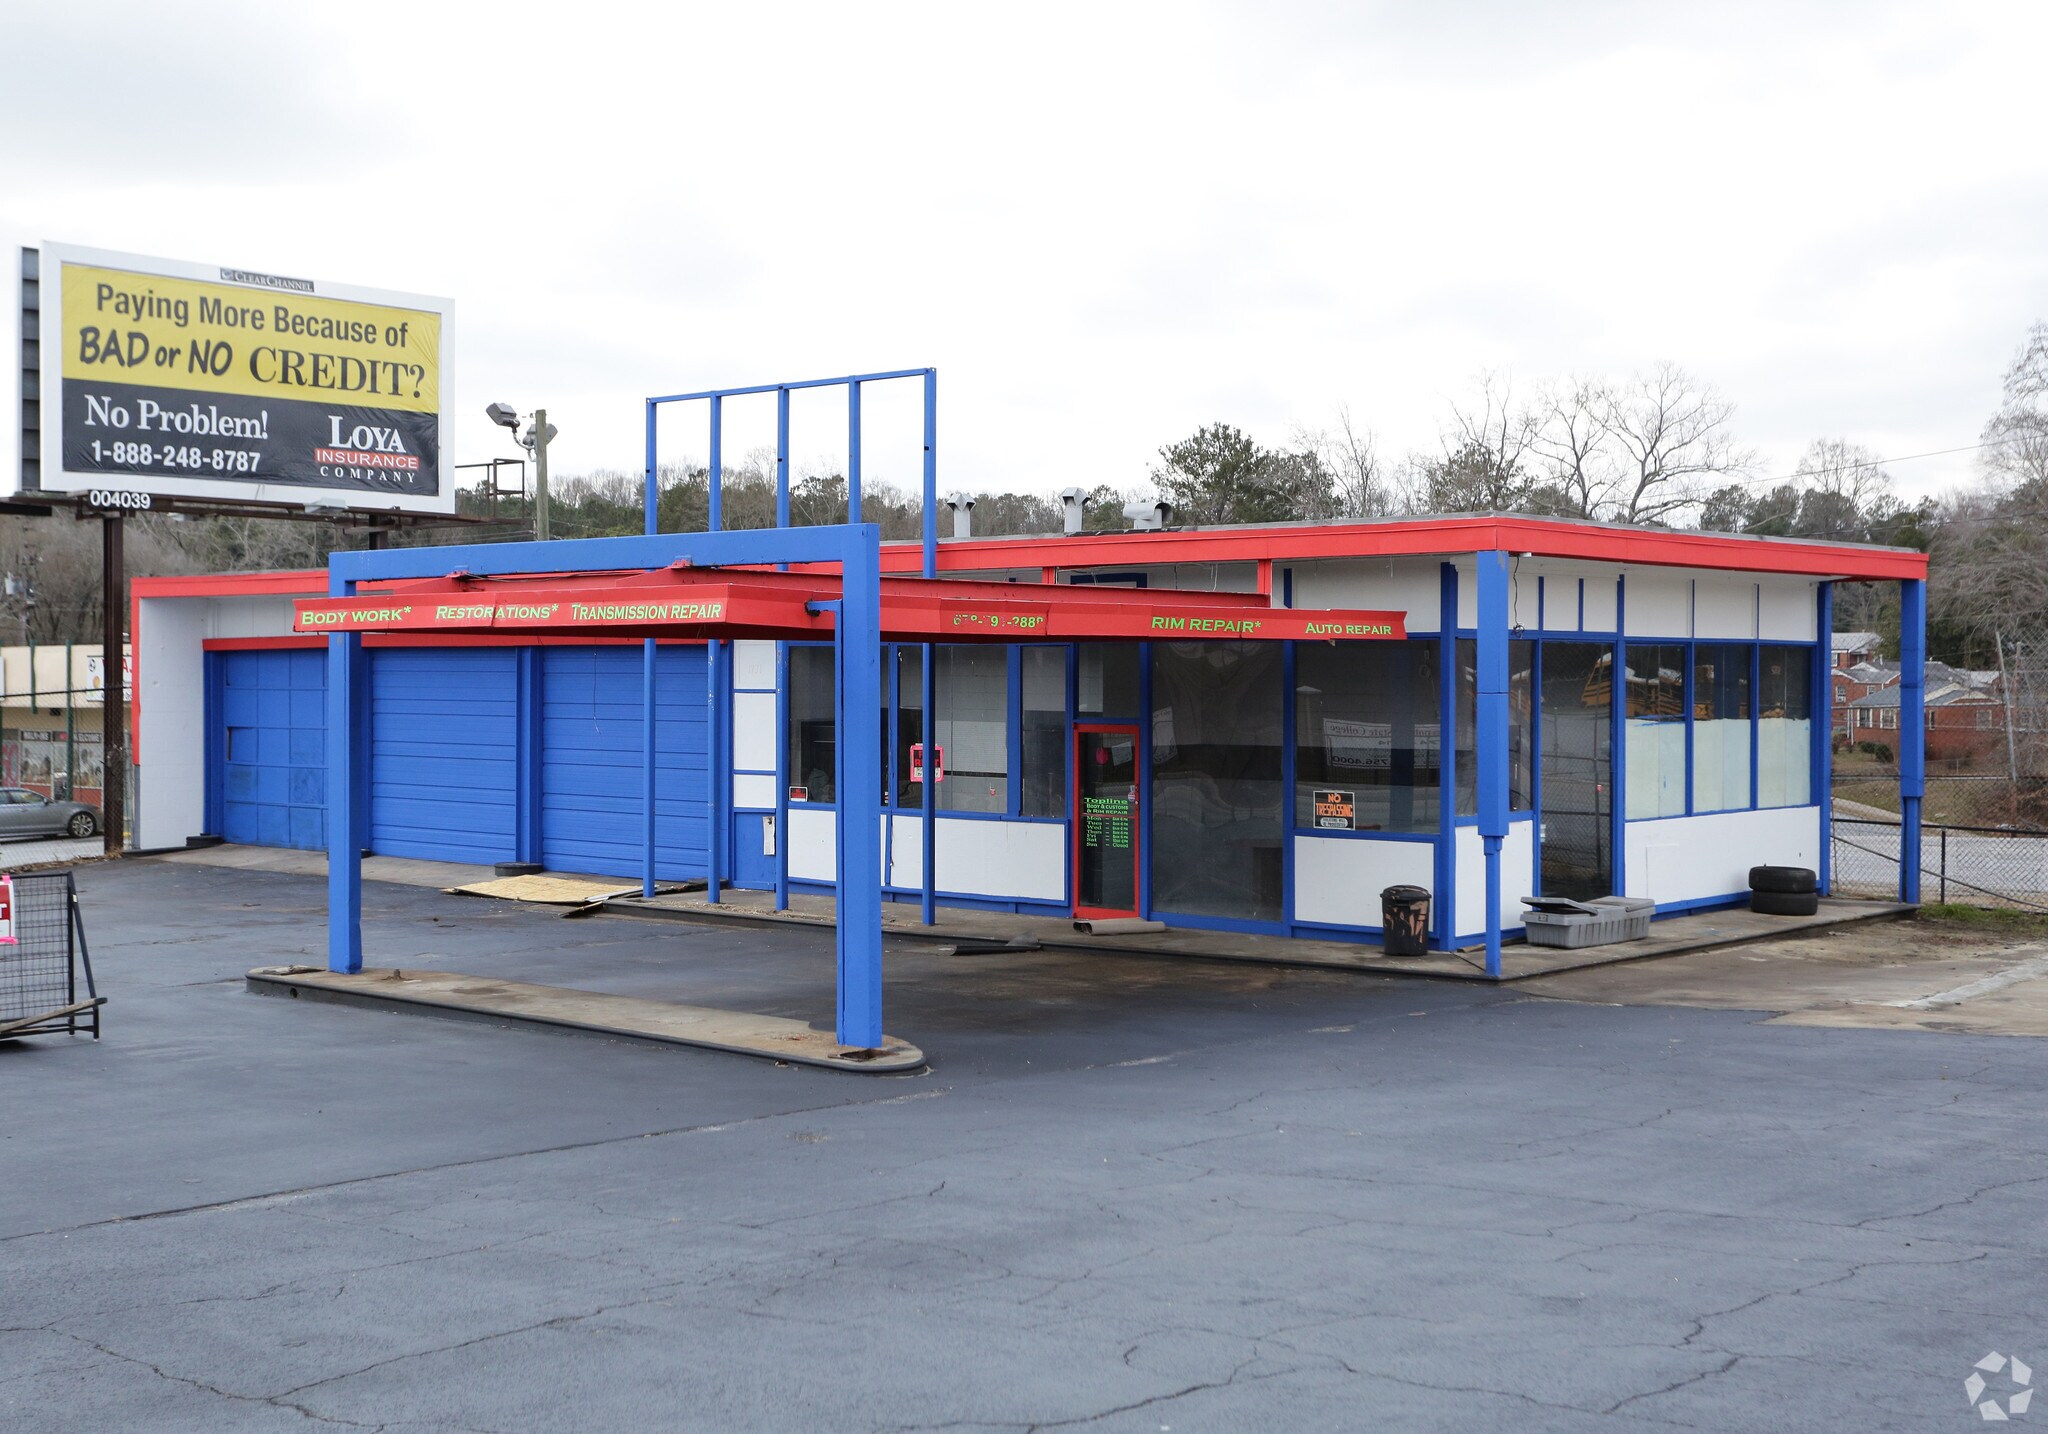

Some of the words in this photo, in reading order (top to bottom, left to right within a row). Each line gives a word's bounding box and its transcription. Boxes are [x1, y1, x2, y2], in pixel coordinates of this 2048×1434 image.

[97, 283, 189, 328] Paying
[199, 296, 265, 331] More
[274, 305, 377, 344] Because
[385, 322, 408, 347] of
[79, 326, 149, 368] BAD
[155, 346, 181, 368] or
[188, 339, 233, 376] NO
[249, 346, 425, 399] CREDIT?
[84, 394, 130, 429] No
[137, 398, 269, 440] Problem!
[328, 414, 407, 453] LOYA
[91, 439, 261, 473] 1-888-248-8787
[316, 449, 418, 470] INSURANCE
[320, 465, 415, 483] COMPANY
[89, 490, 151, 510] 004039
[301, 611, 347, 625] BODY
[571, 603, 667, 620] TRANSMISSION
[670, 604, 722, 619] REPAIR
[1151, 616, 1185, 630] RIM
[1305, 622, 1343, 635] AUTO
[1346, 624, 1392, 635] REPAIR
[1328, 793, 1342, 803] NO
